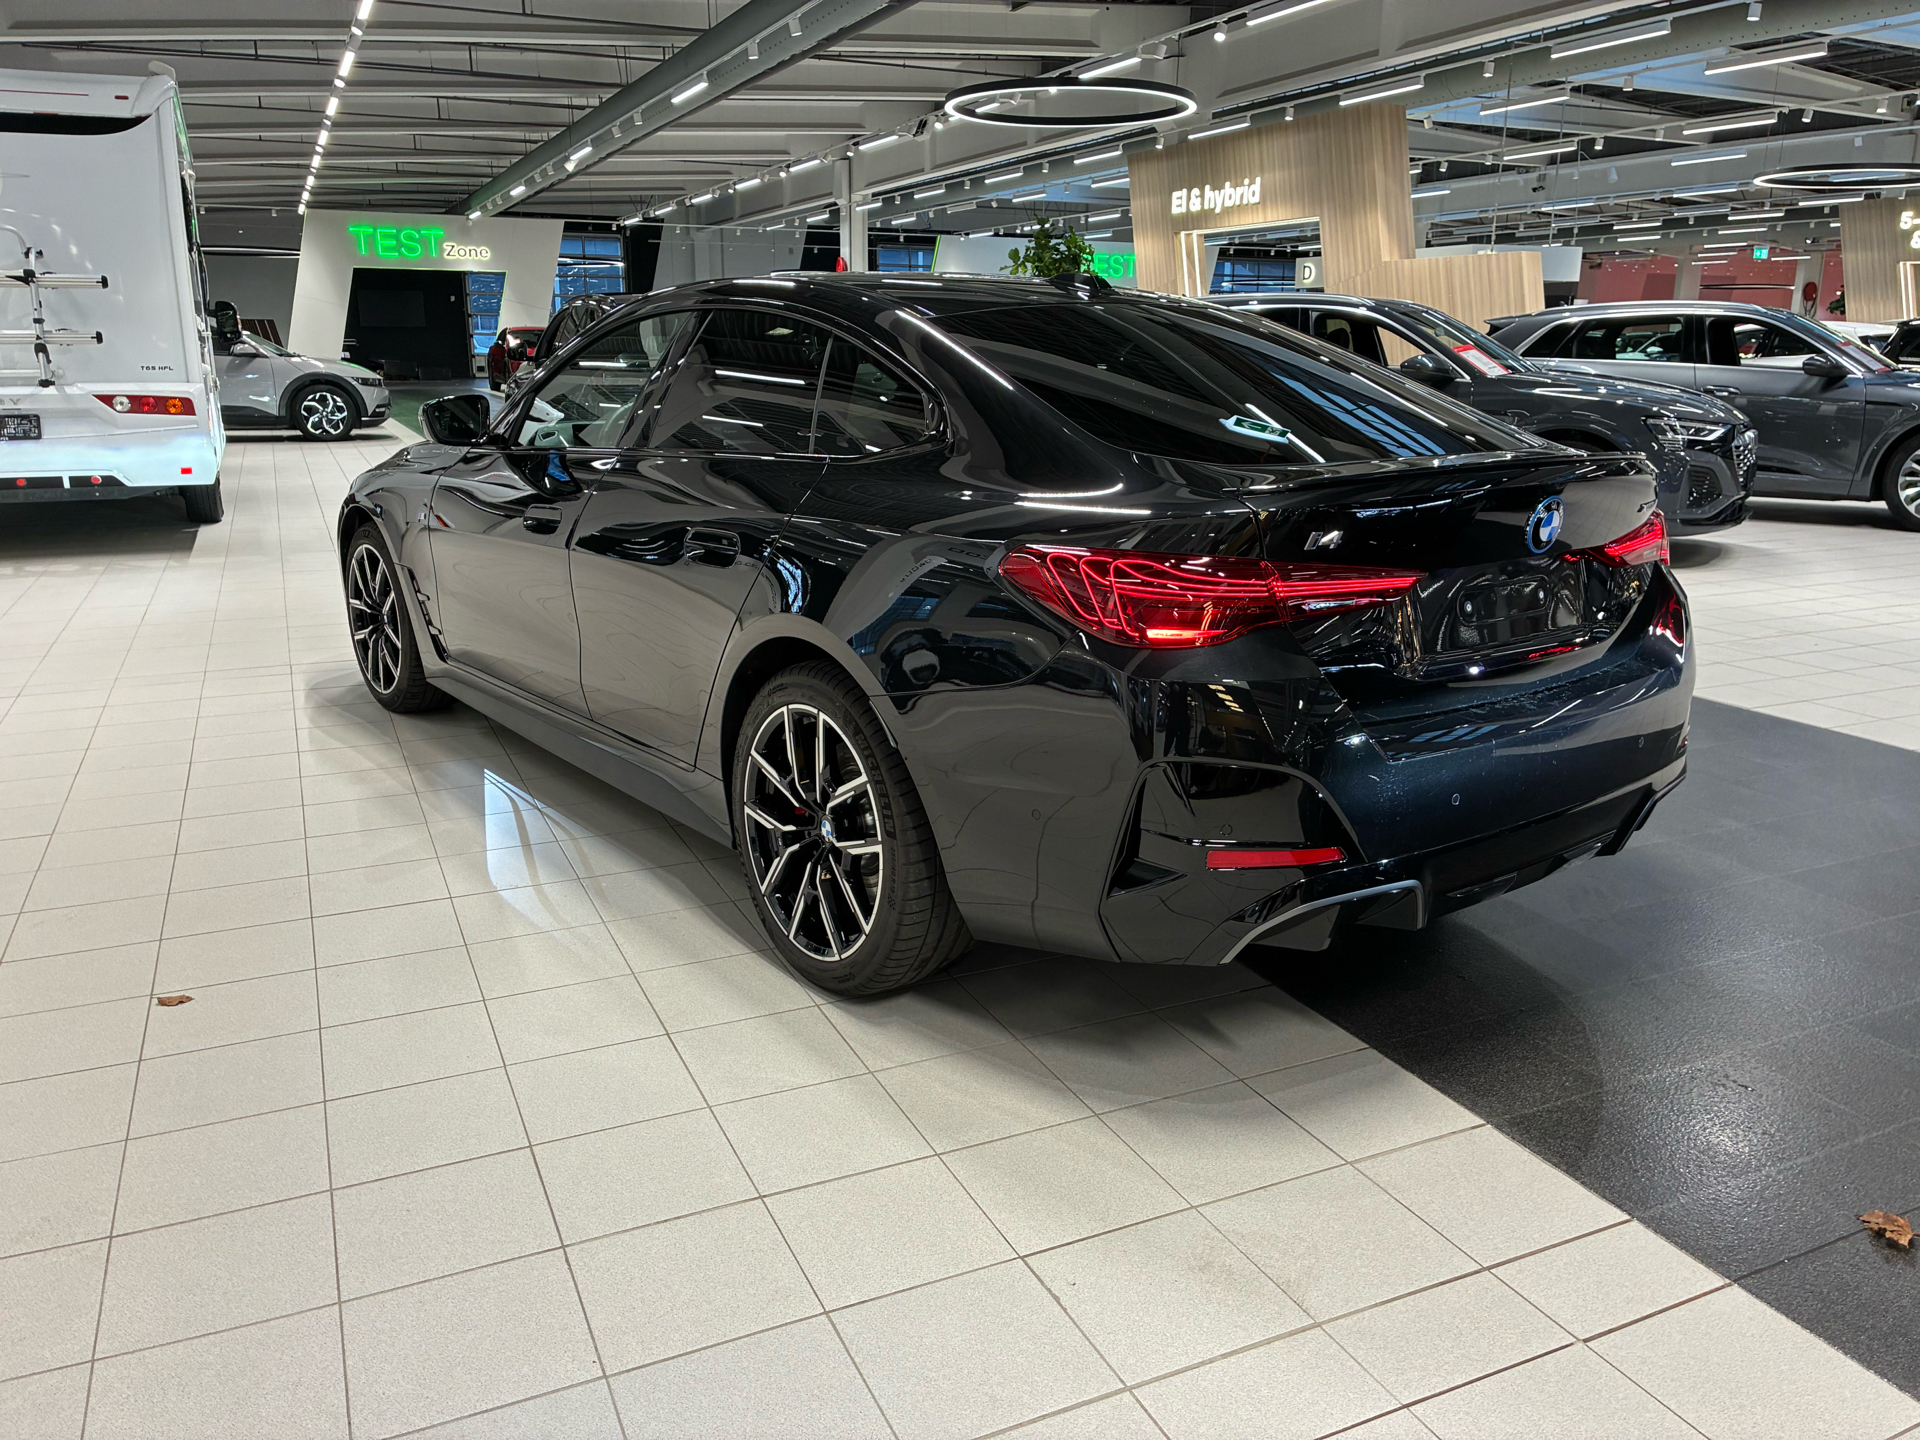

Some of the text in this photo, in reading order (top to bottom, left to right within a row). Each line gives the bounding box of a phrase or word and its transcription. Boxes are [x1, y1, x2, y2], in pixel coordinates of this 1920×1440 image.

[1171, 176, 1261, 214] El & hybrid
[349, 225, 490, 259] TEST Zone
[1083, 253, 1136, 278] EST
[1302, 265, 1313, 282] D
[1304, 530, 1344, 551] i4
